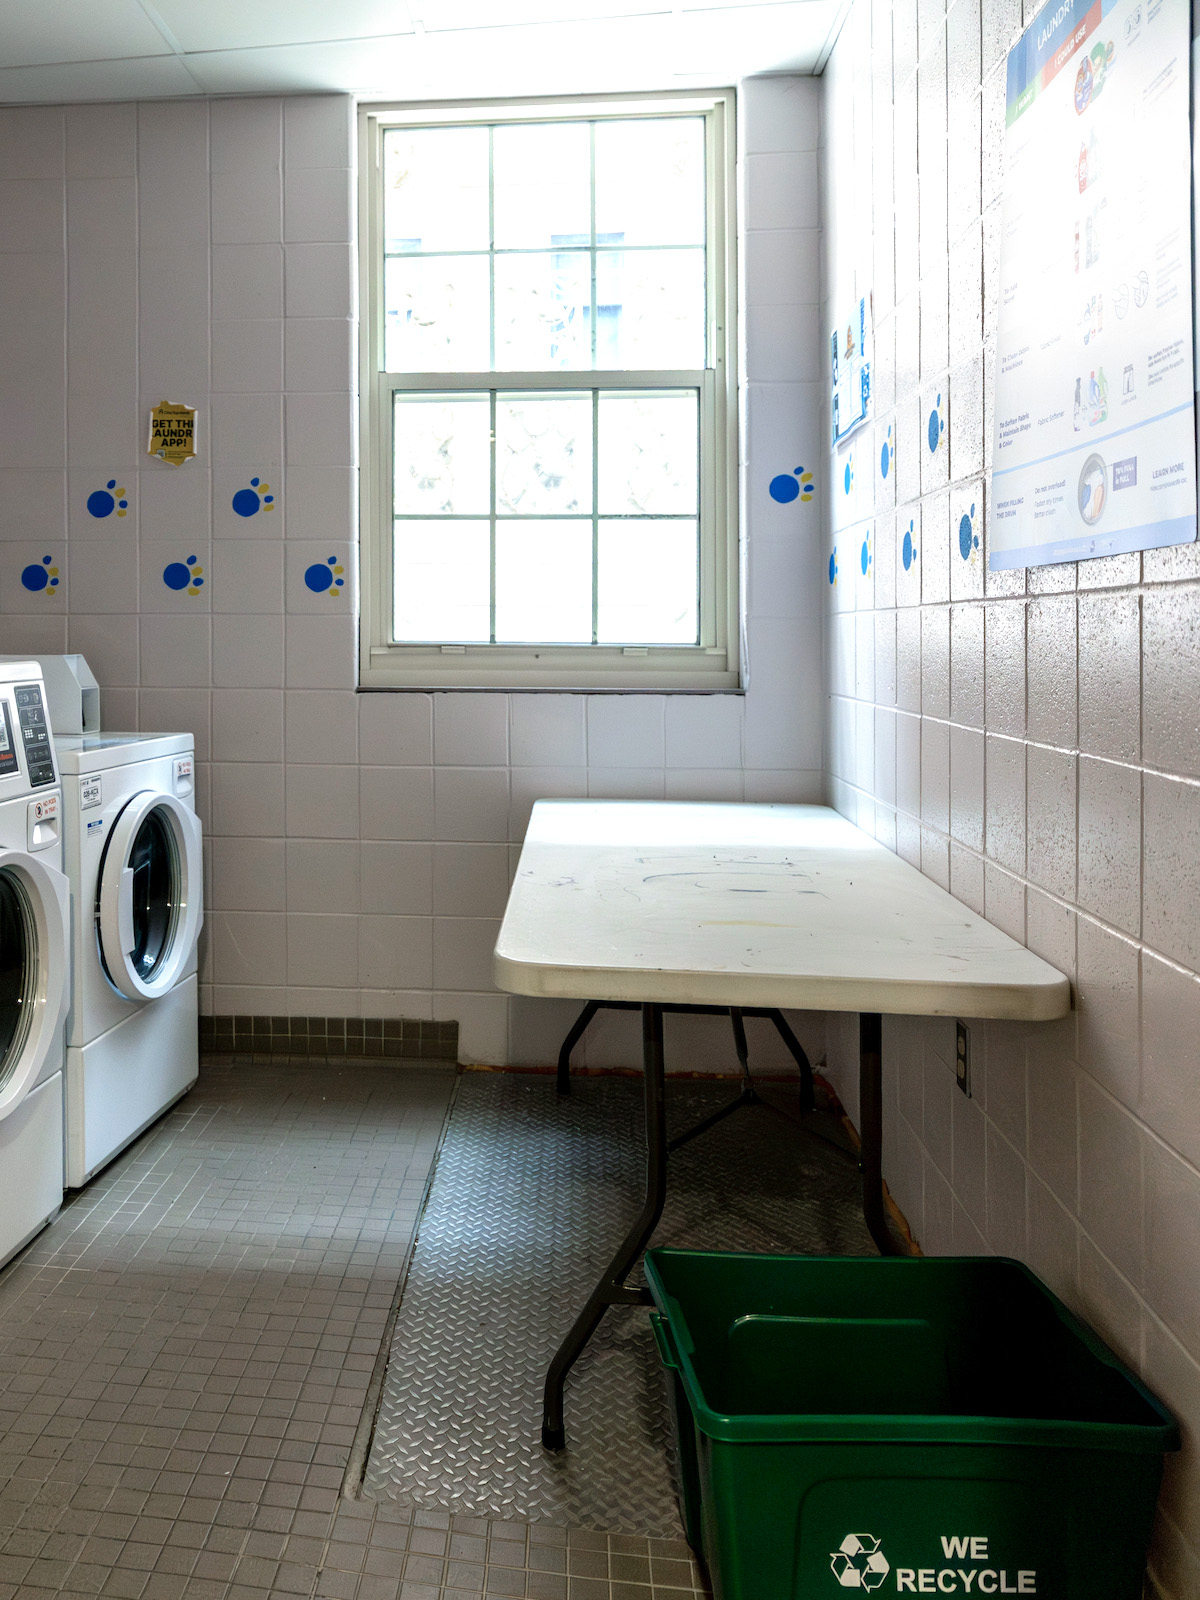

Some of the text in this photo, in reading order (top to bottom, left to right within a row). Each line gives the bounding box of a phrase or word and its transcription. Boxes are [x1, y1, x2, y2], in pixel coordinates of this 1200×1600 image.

[152, 419, 173, 428] GET
[152, 429, 193, 437] AUNDR
[161, 438, 186, 447] APP!
[941, 1536, 989, 1559] WE
[896, 1568, 1037, 1594] RECYCLE
